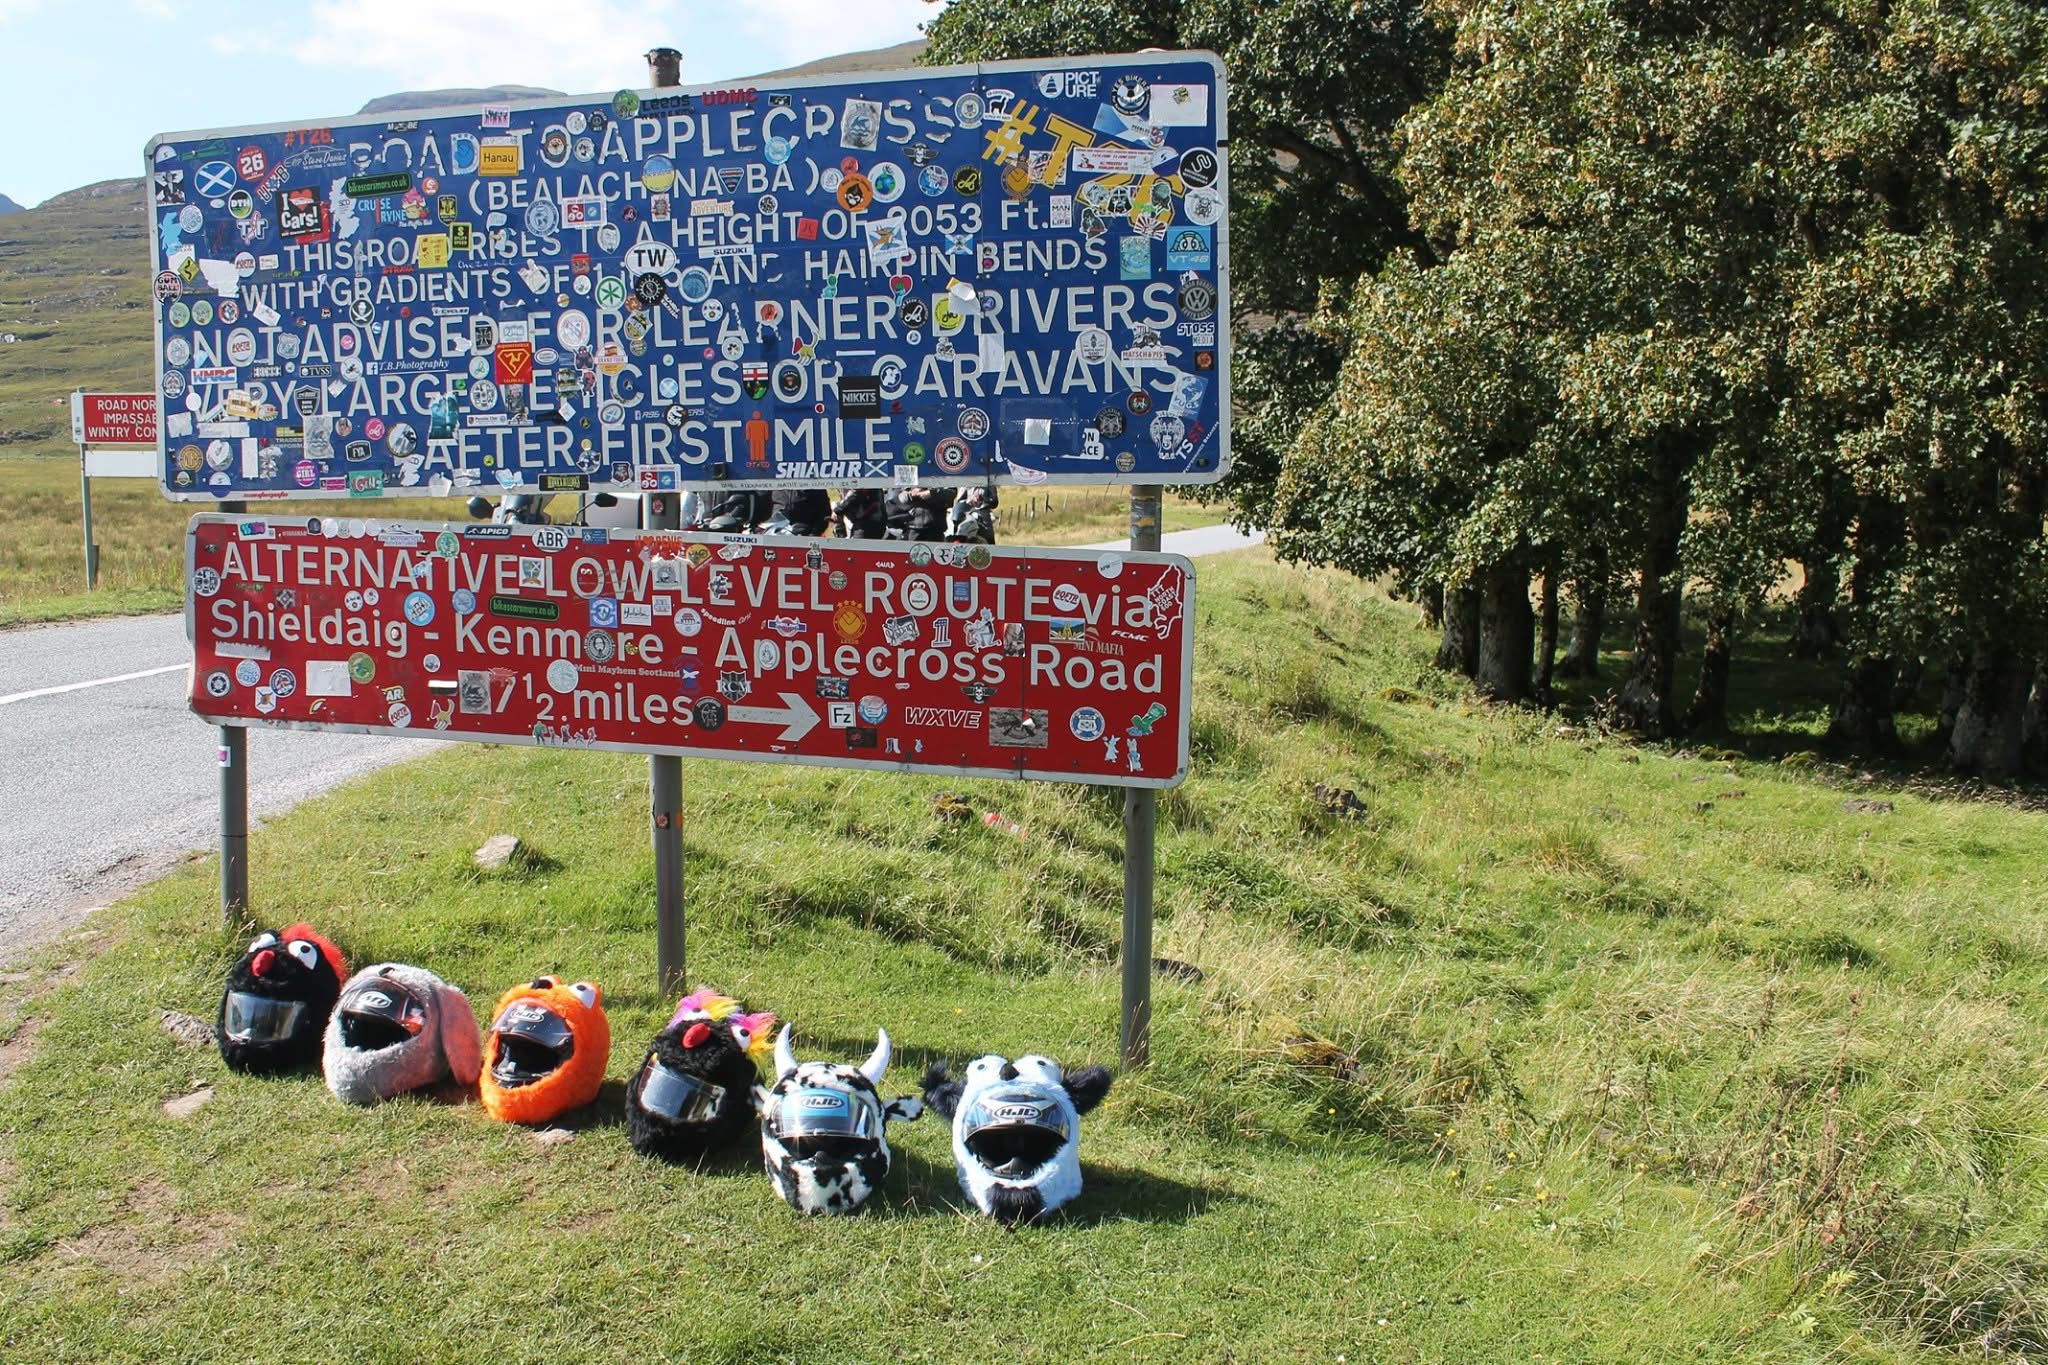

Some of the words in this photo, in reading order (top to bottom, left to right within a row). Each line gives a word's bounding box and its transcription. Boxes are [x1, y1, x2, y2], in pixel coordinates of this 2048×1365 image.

[1065, 71, 1099, 84] PICT
[1065, 84, 1097, 97] URE
[598, 96, 955, 165] APPLECRSS
[241, 152, 264, 174] 26
[483, 151, 514, 163] Hanau
[674, 166, 723, 198] NA
[281, 205, 320, 230] Cars!
[284, 240, 353, 273] THIS
[368, 237, 453, 268] RO
[637, 221, 657, 243] A
[672, 211, 803, 248] HEIGHT
[822, 209, 868, 240] OF
[634, 249, 667, 267] TW
[713, 247, 748, 256] SUZUKI
[241, 281, 319, 311] WITH
[331, 267, 512, 307] GRADIENTS
[805, 246, 956, 281] HAIRPIN
[976, 237, 1108, 275] BENDS
[193, 327, 283, 367] NOT
[301, 314, 499, 365] ADVISED
[528, 308, 625, 352] FOR
[654, 295, 898, 347] LEARNER
[932, 282, 1177, 337] DRIVERS
[1176, 322, 1214, 335] STOSS
[322, 372, 470, 417] LARGE
[499, 360, 742, 412] EICLES
[872, 346, 1183, 401] CARAVANS
[97, 399, 128, 411] ROAD
[842, 392, 876, 404] NIKKI'S
[88, 426, 130, 438] WINTRY
[424, 425, 575, 470] AFTER
[601, 420, 742, 465] FIRST
[774, 416, 893, 462] MILE
[776, 461, 846, 479] SHIACH
[480, 527, 509, 536] APICO
[723, 535, 758, 544] SUZUKI
[536, 534, 564, 547] ABR
[221, 541, 521, 595] ALTERNATIVE
[545, 556, 654, 601] LOW
[681, 563, 834, 612] LEVEL
[865, 571, 1051, 622] ROUTE
[1081, 585, 1154, 629] via
[211, 598, 408, 658] Shieldaig
[455, 612, 664, 664] Kenmre
[715, 626, 1006, 684] Applecross
[1030, 644, 1162, 693] Road
[1096, 643, 1124, 656] MAFIA
[598, 665, 637, 676] Mayhem
[638, 667, 680, 679] Scotland
[716, 680, 752, 693] RCM
[574, 682, 694, 726] miles
[833, 707, 851, 724] Fz
[904, 706, 982, 729] WXVE
[999, 1108, 1036, 1117] HJC
